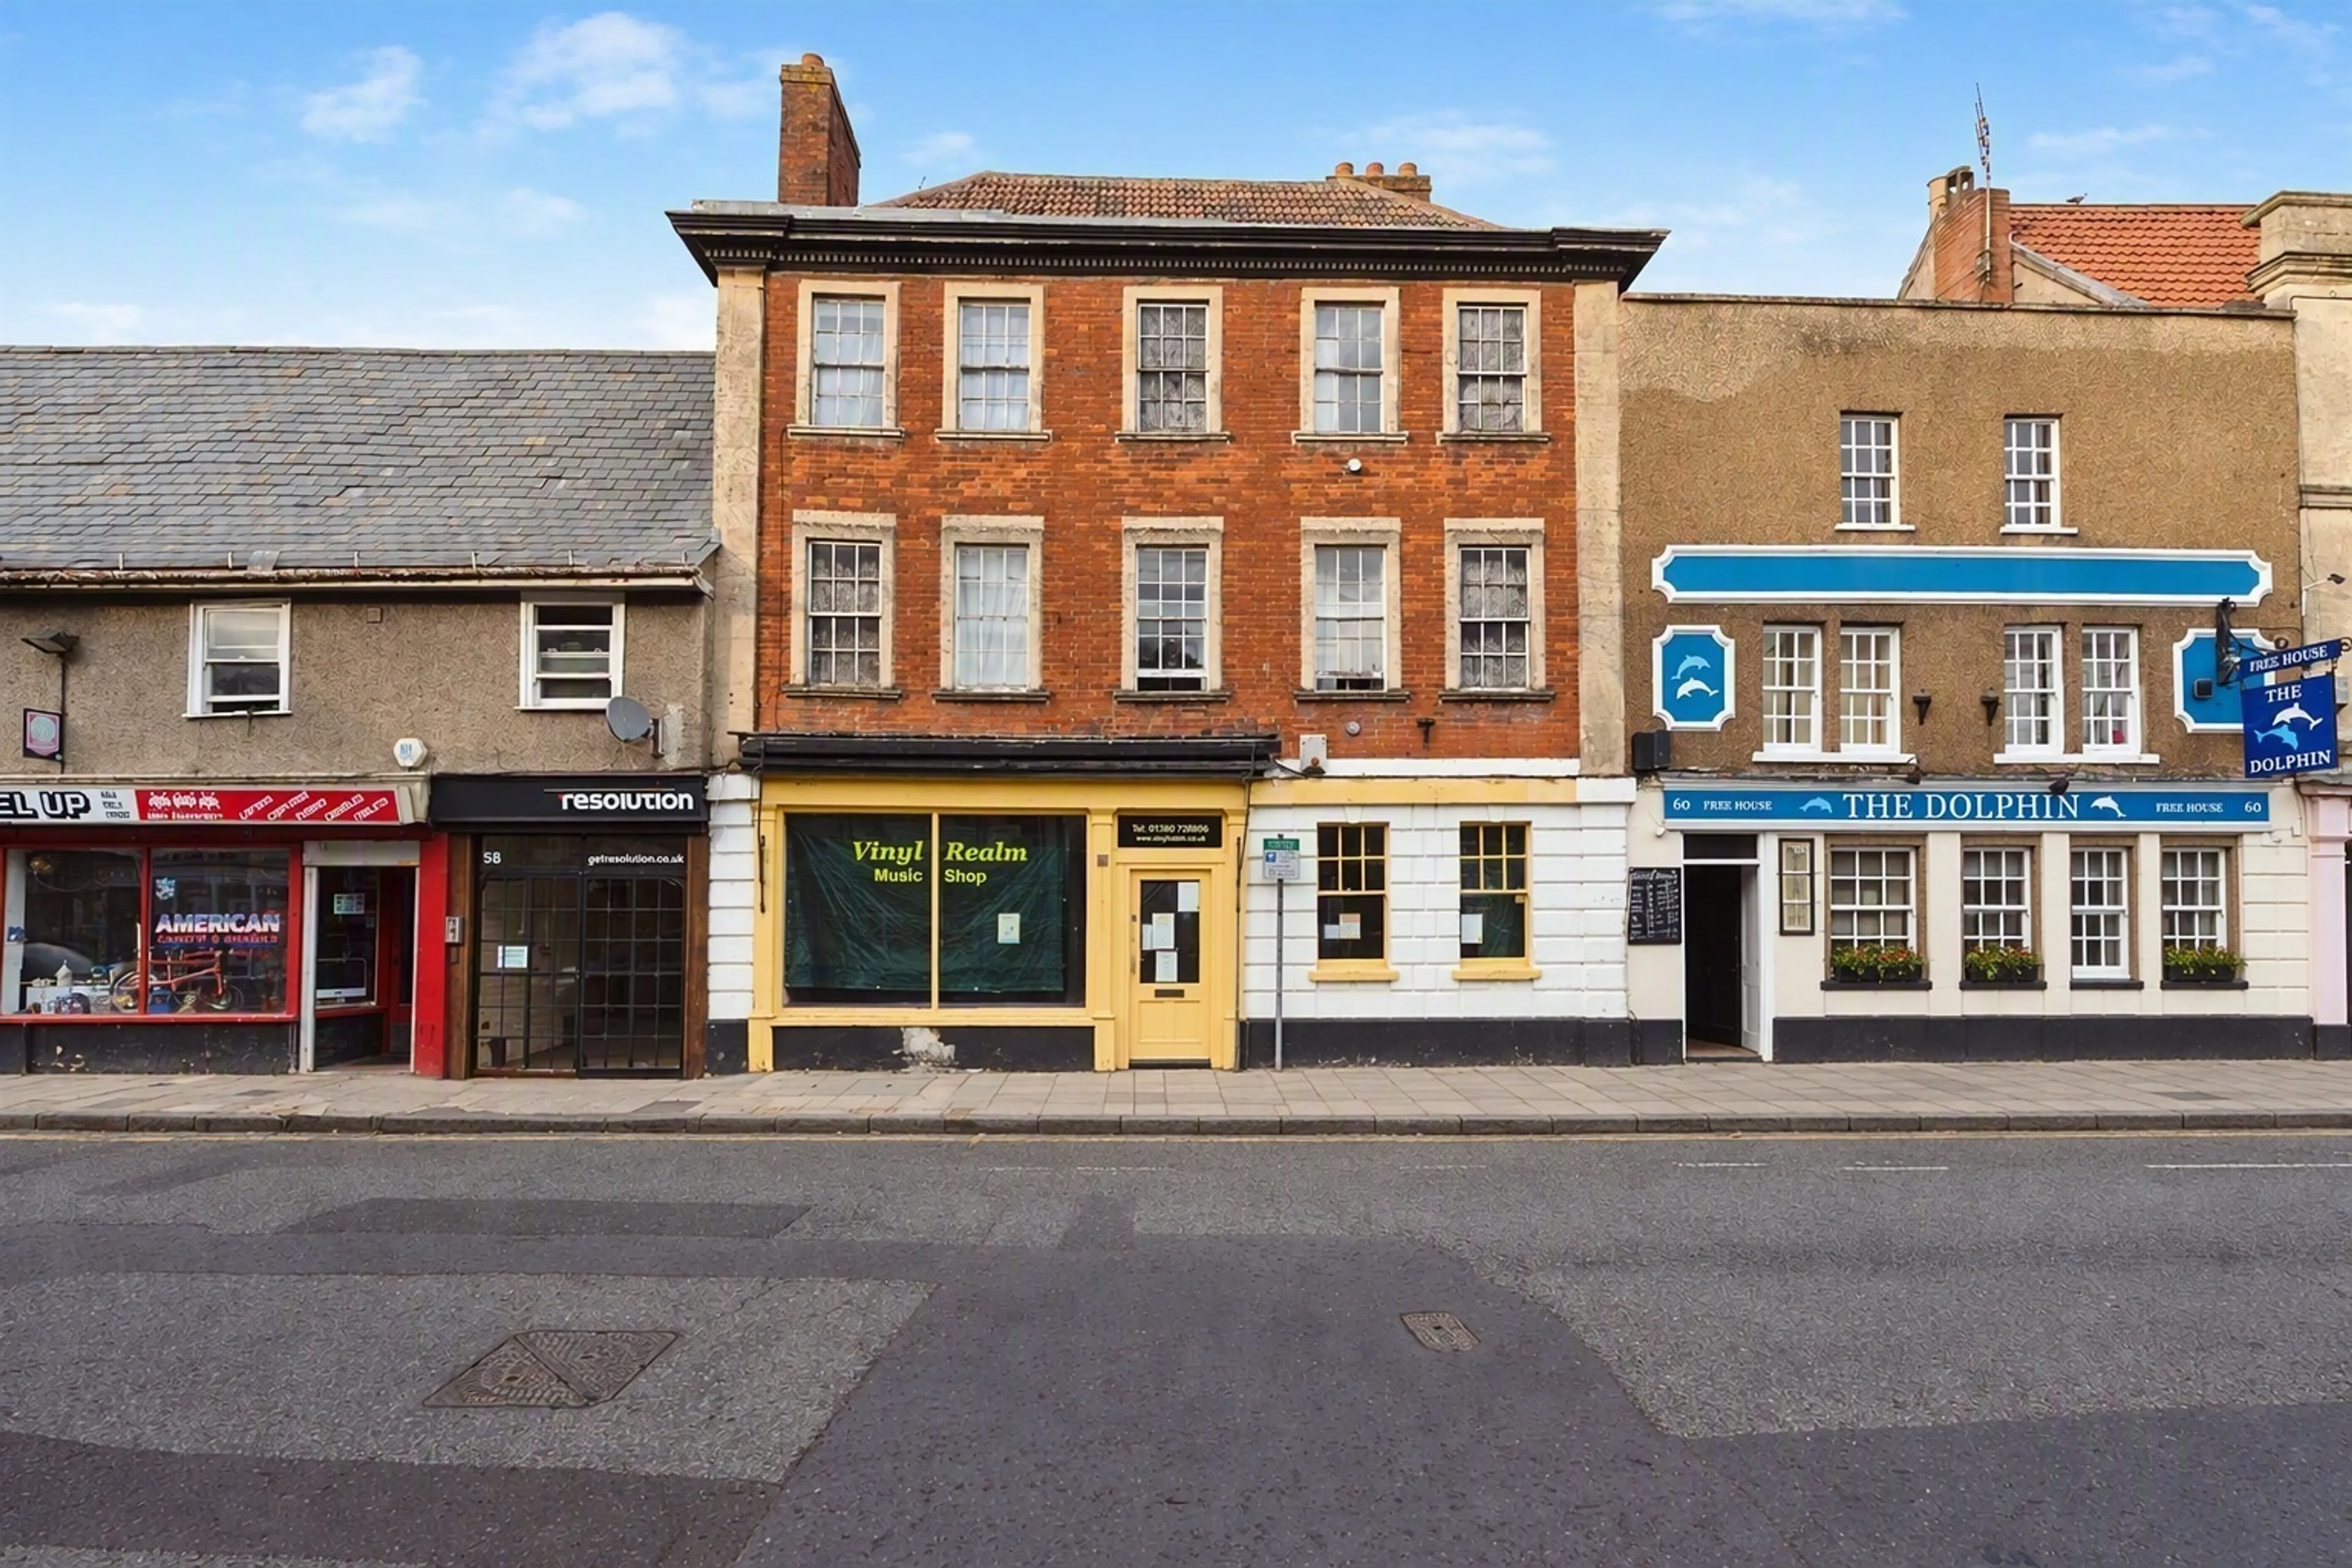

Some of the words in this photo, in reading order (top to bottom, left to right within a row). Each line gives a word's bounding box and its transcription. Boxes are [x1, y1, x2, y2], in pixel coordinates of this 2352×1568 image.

[2249, 655, 2279, 672] FREE
[2283, 645, 2328, 665] HOUSE
[2264, 684, 2303, 703] THE
[2250, 750, 2331, 774] DOLPHIN
[39, 791, 91, 819] UP
[562, 793, 694, 810] resolution
[1673, 797, 1691, 811] 60
[1703, 800, 1732, 811] FREE
[1735, 801, 1773, 811] HOUSE
[1843, 794, 1913, 819] THE
[1924, 794, 2079, 819] DOLPHIN
[2156, 802, 2184, 813] FREE
[2187, 802, 2223, 813] HOUSE
[2244, 801, 2262, 813] 60
[483, 851, 502, 864] 58
[588, 853, 685, 866] getresolution.co.uk
[853, 840, 924, 865] Vinyl
[944, 842, 1028, 862] Realm
[874, 868, 924, 882] Music
[944, 869, 987, 886] Shop
[155, 913, 281, 933] AMERICAN
